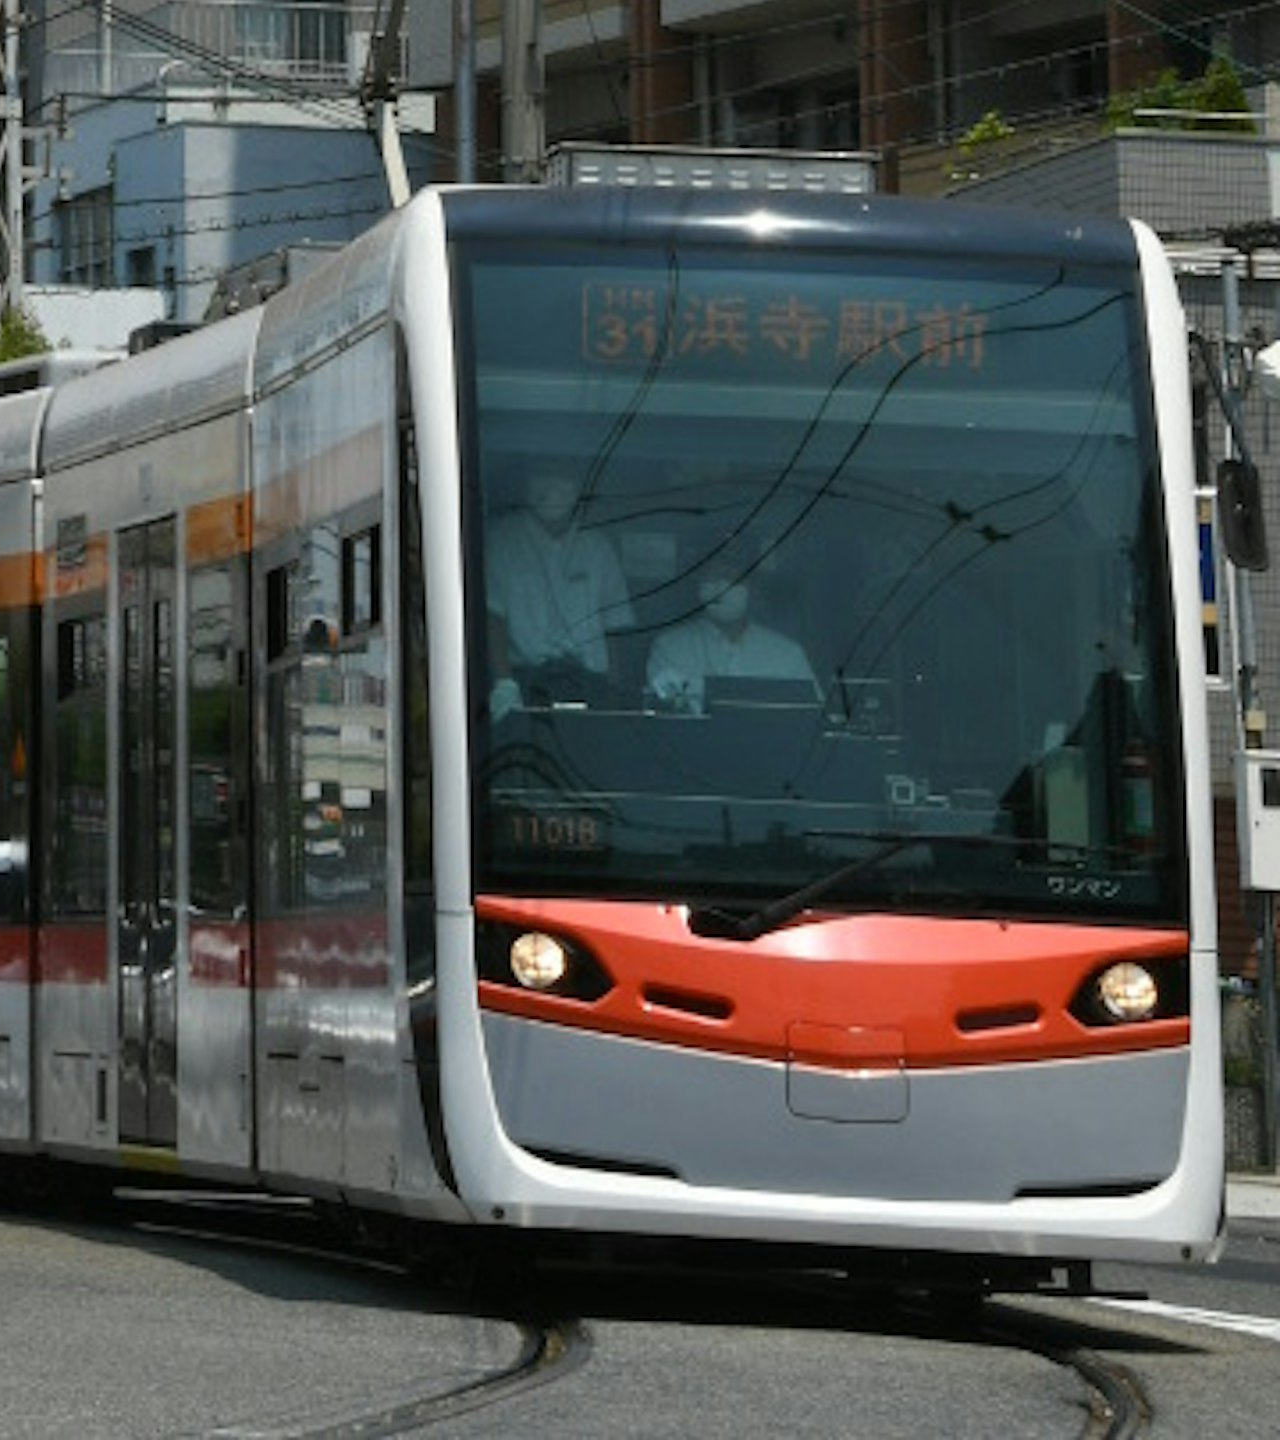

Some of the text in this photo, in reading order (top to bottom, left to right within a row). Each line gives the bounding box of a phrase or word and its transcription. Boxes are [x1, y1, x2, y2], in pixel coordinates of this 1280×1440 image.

[597, 315, 657, 358] 31
[680, 294, 990, 370] 浜寺駅前
[1047, 876, 1122, 899] ワンマン
